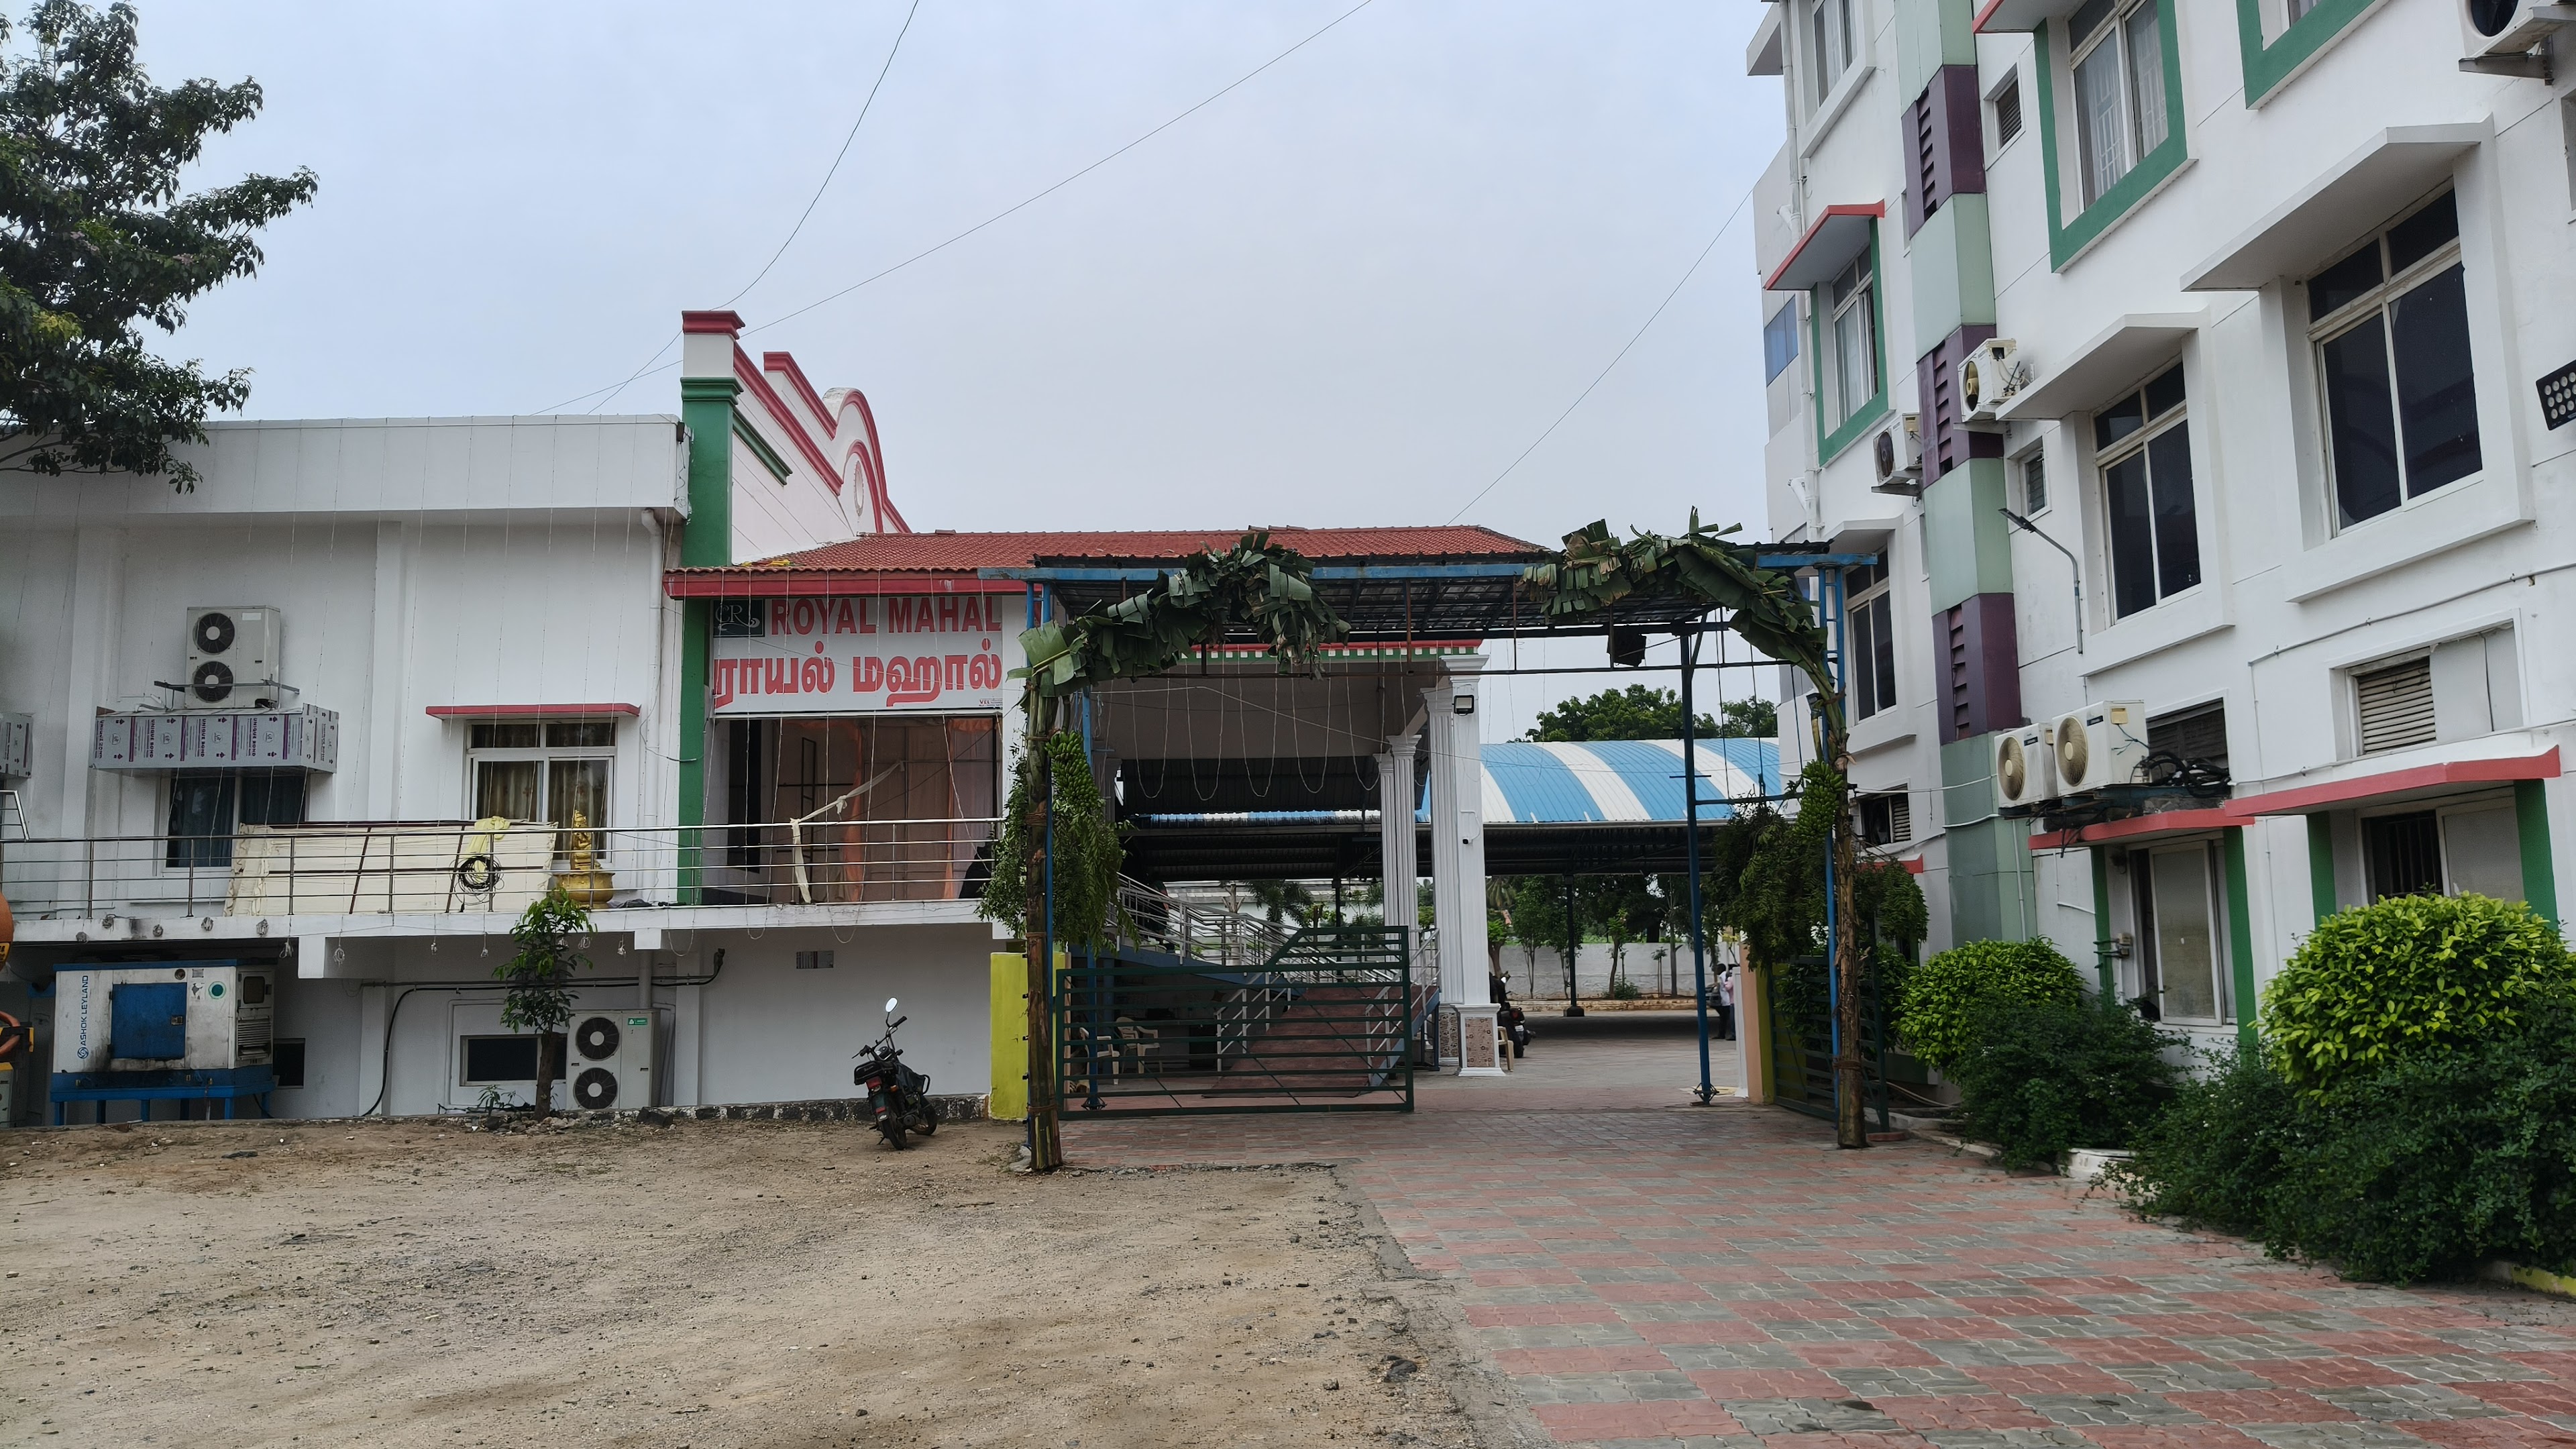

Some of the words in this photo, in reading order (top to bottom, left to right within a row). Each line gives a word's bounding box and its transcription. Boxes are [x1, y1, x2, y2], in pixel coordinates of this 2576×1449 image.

[771, 598, 876, 635] ROYAL
[888, 596, 1002, 633] MAHAL
[713, 641, 835, 709] ராயல்
[853, 638, 1002, 708] மஹால்
